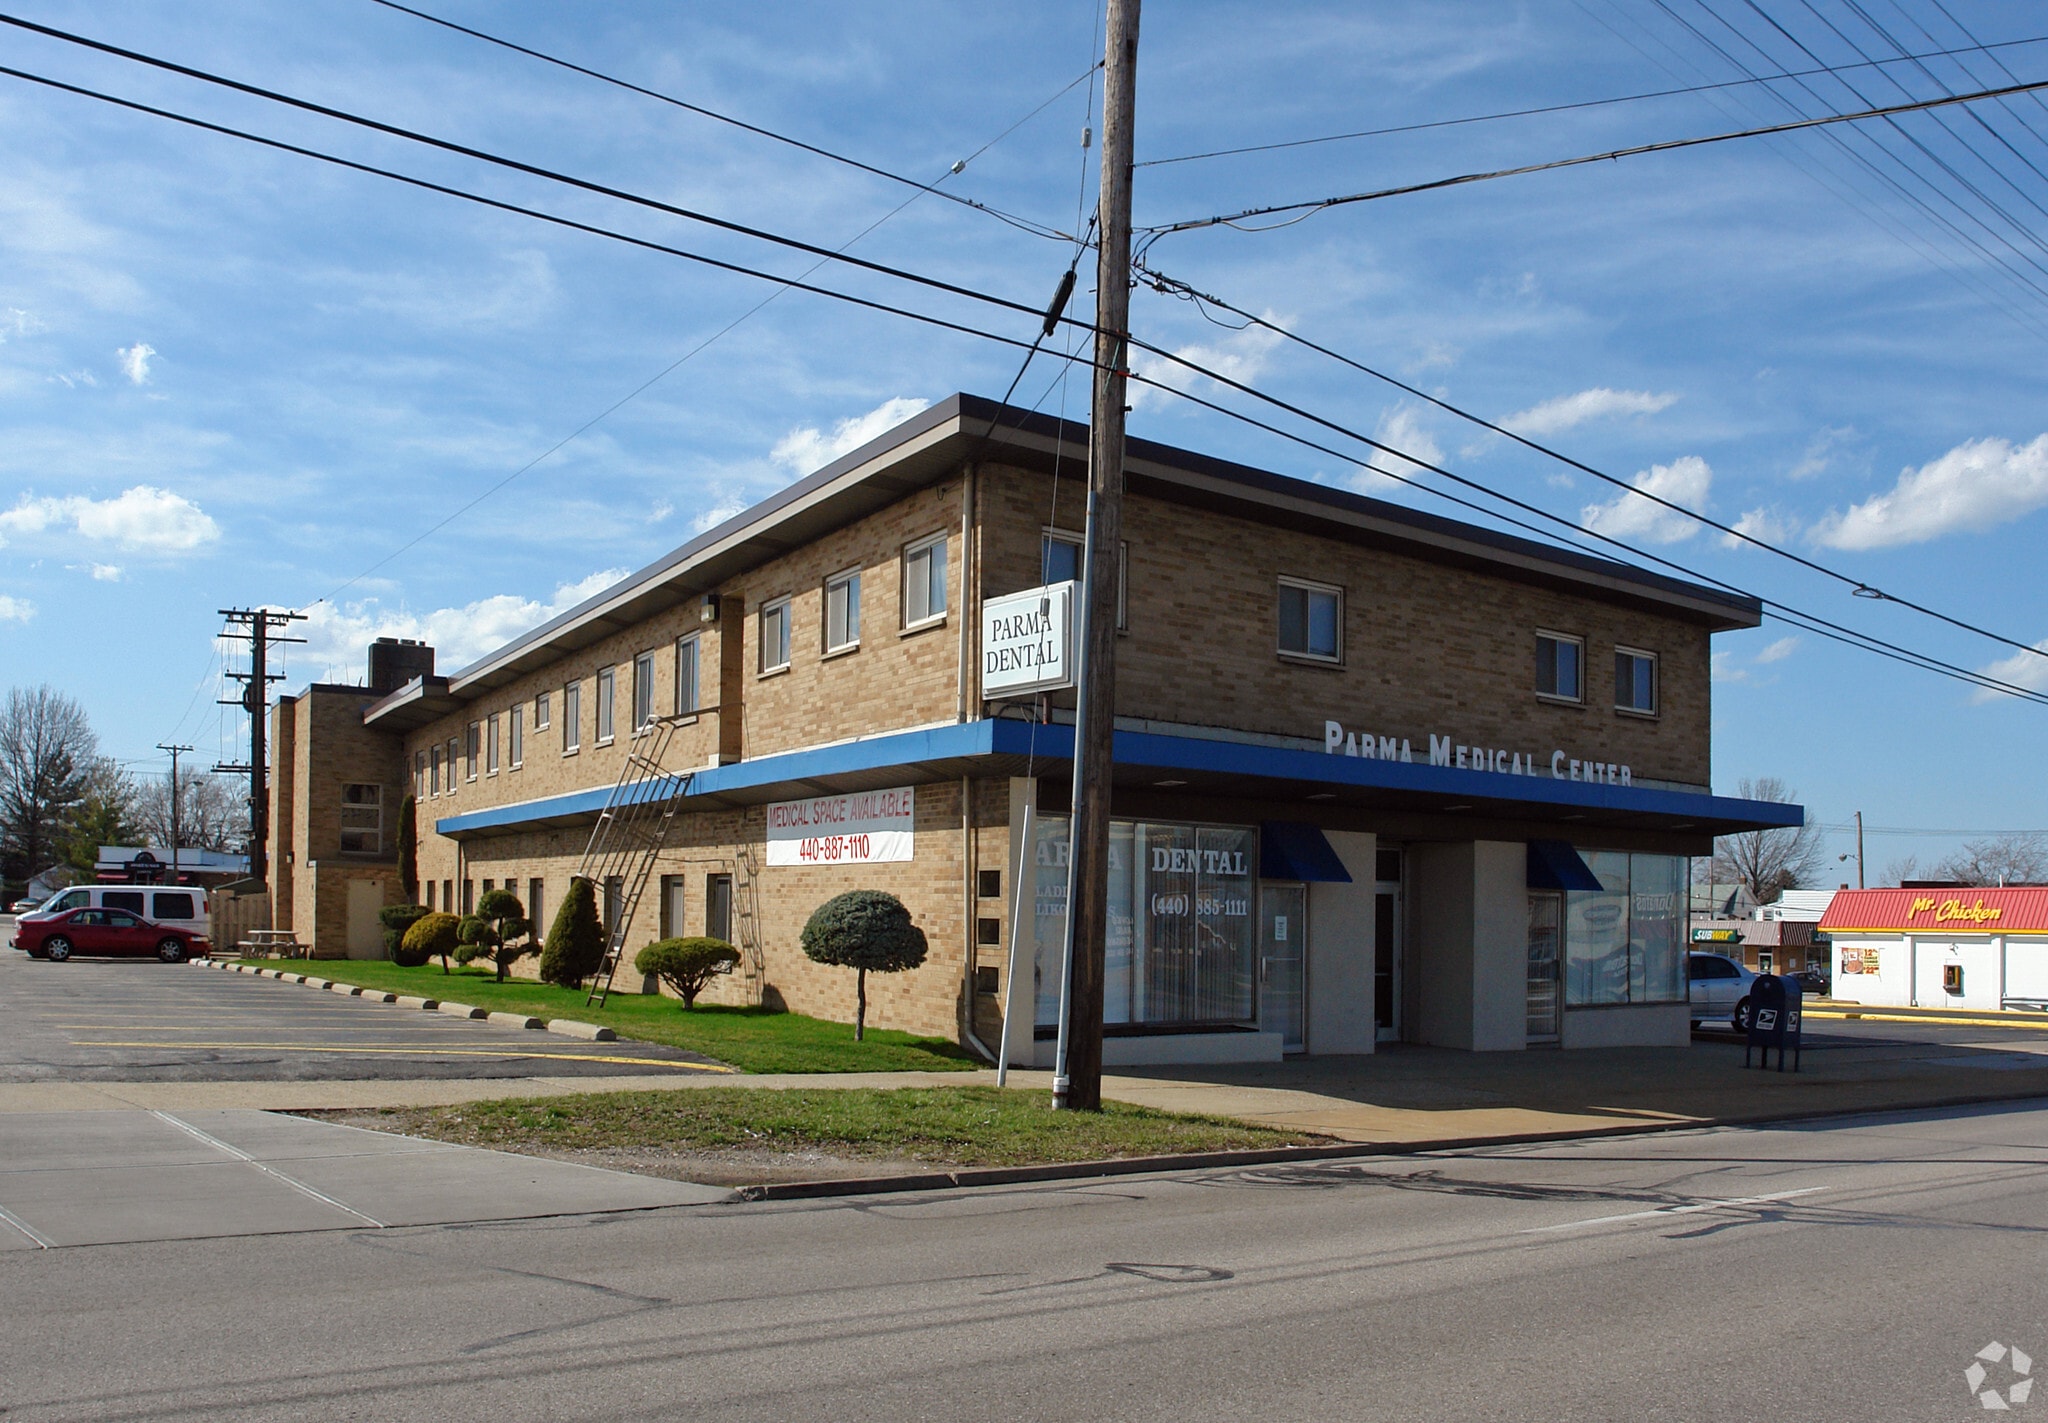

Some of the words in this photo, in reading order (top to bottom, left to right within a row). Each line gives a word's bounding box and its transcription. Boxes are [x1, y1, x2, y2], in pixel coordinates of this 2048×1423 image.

[992, 612, 1053, 642] PARMA
[986, 640, 1059, 674] DENTAL
[1325, 720, 1413, 763] PARMA
[1429, 733, 1537, 777] MEDICAL
[1551, 750, 1632, 787] CENTER
[768, 801, 809, 829] MEDICAL
[813, 797, 846, 824] SPACE
[850, 790, 912, 820] AVAILABLE
[799, 834, 870, 862] 440-887-1110
[1151, 846, 1248, 875] DENTAL
[1151, 893, 1189, 917] (440)
[1196, 898, 1247, 916] 885-1111
[1908, 898, 1937, 919] Mr.
[1936, 899, 2002, 923] Chicken
[1694, 929, 1733, 941] SUBWAY
